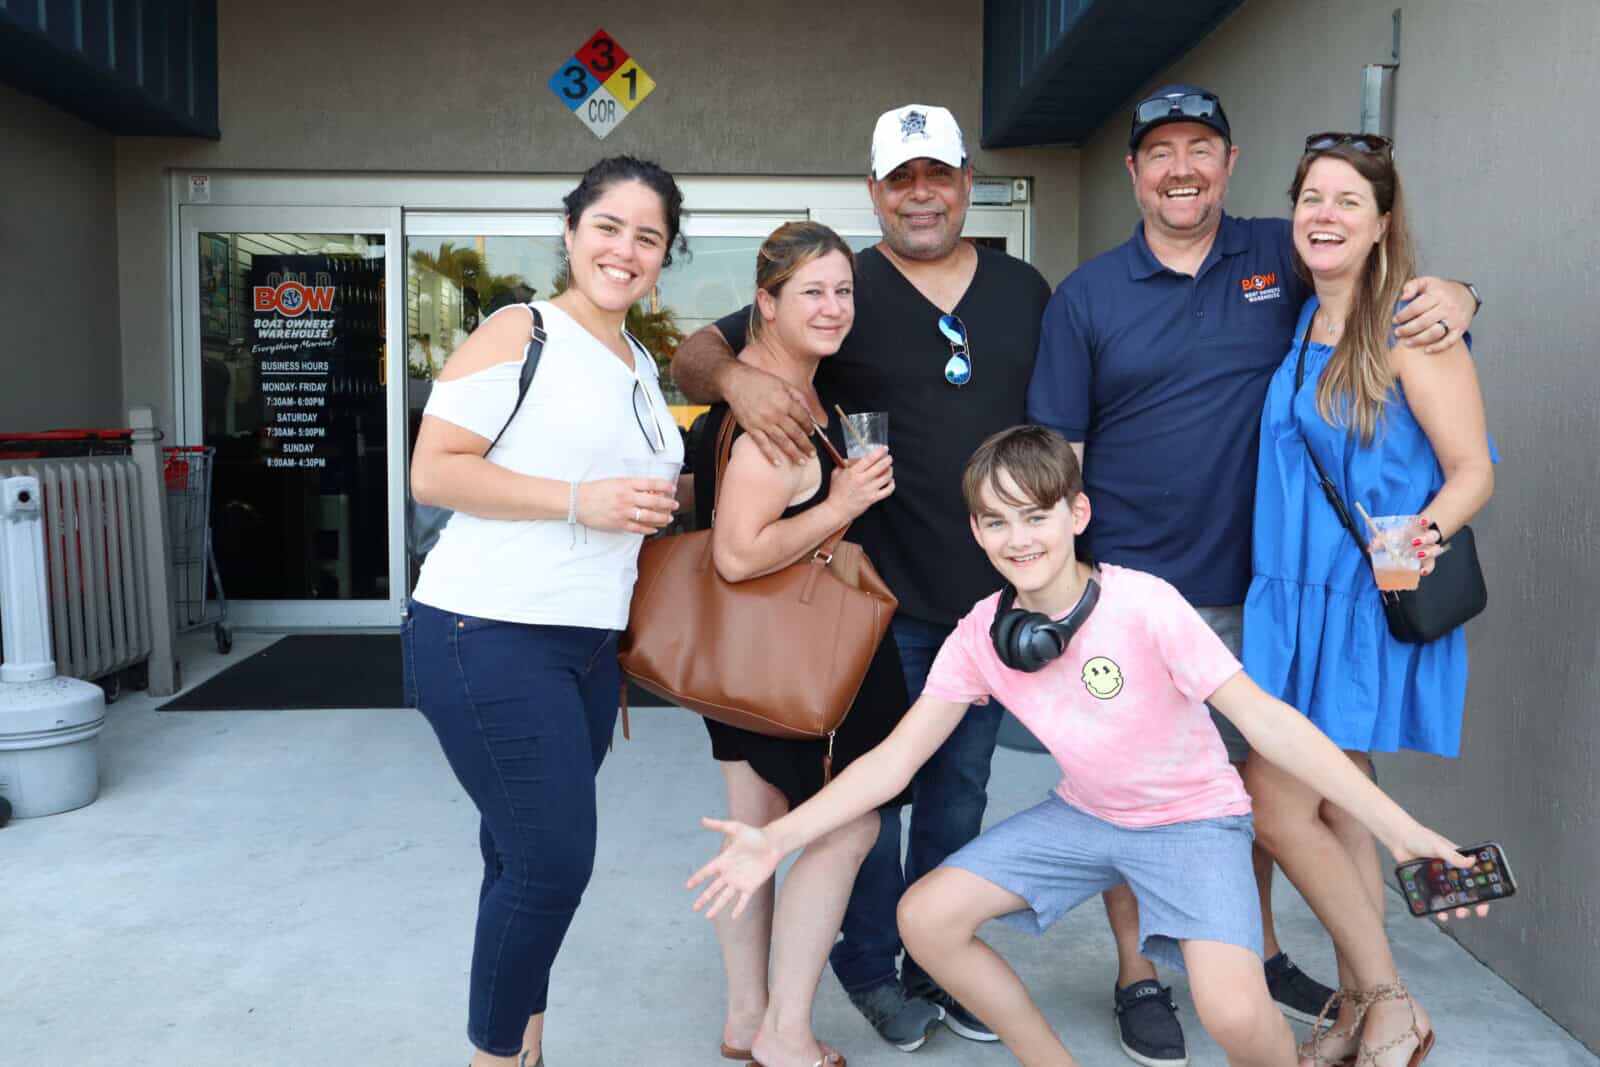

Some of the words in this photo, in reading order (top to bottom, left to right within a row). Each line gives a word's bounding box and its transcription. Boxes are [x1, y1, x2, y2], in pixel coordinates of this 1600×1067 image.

[591, 38, 616, 73] 3
[562, 65, 588, 100] 3
[621, 68, 637, 100] 1
[588, 98, 616, 123] COR
[1241, 272, 1276, 291] BOW
[253, 281, 336, 317] BOW
[254, 319, 283, 329] BOAT
[286, 319, 336, 329] OWNERS
[258, 329, 329, 339] WAREHOUSE
[252, 342, 298, 355] Everything
[300, 337, 337, 350] Marine!
[261, 361, 300, 371] BUSINESS
[301, 361, 329, 371] HOURS
[299, 382, 328, 392] FRIDAY
[297, 397, 325, 406] 6:00PM
[276, 413, 318, 422] SATURDAY
[298, 427, 325, 437] 5:00PM
[283, 443, 314, 453] SUNDAY
[298, 457, 326, 467] 4:30PM
